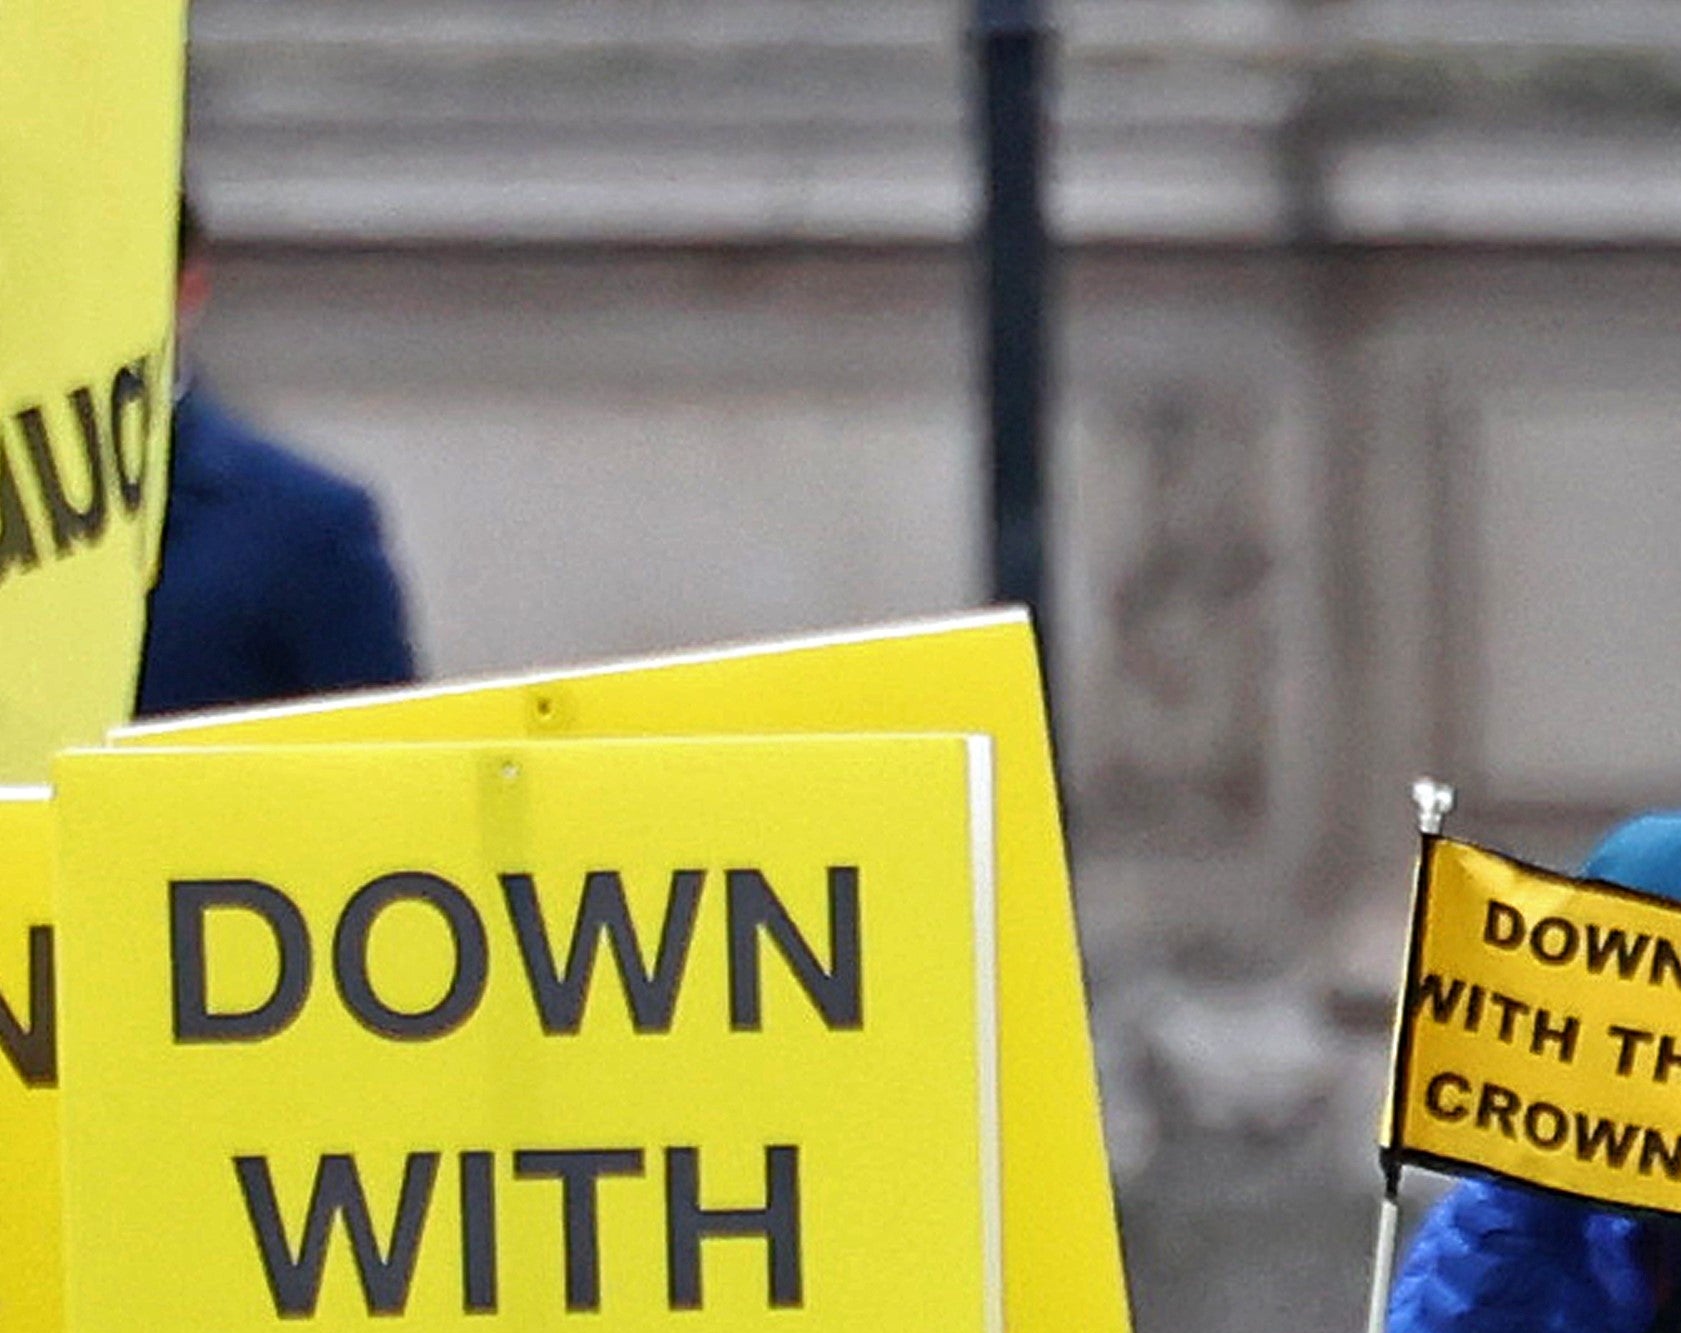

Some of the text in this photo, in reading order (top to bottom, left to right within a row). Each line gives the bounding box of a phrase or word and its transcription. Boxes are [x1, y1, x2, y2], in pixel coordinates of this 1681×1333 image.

[169, 867, 863, 1043] DOWN
[1414, 973, 1580, 1063] WITH
[233, 1145, 802, 1317] WITH
